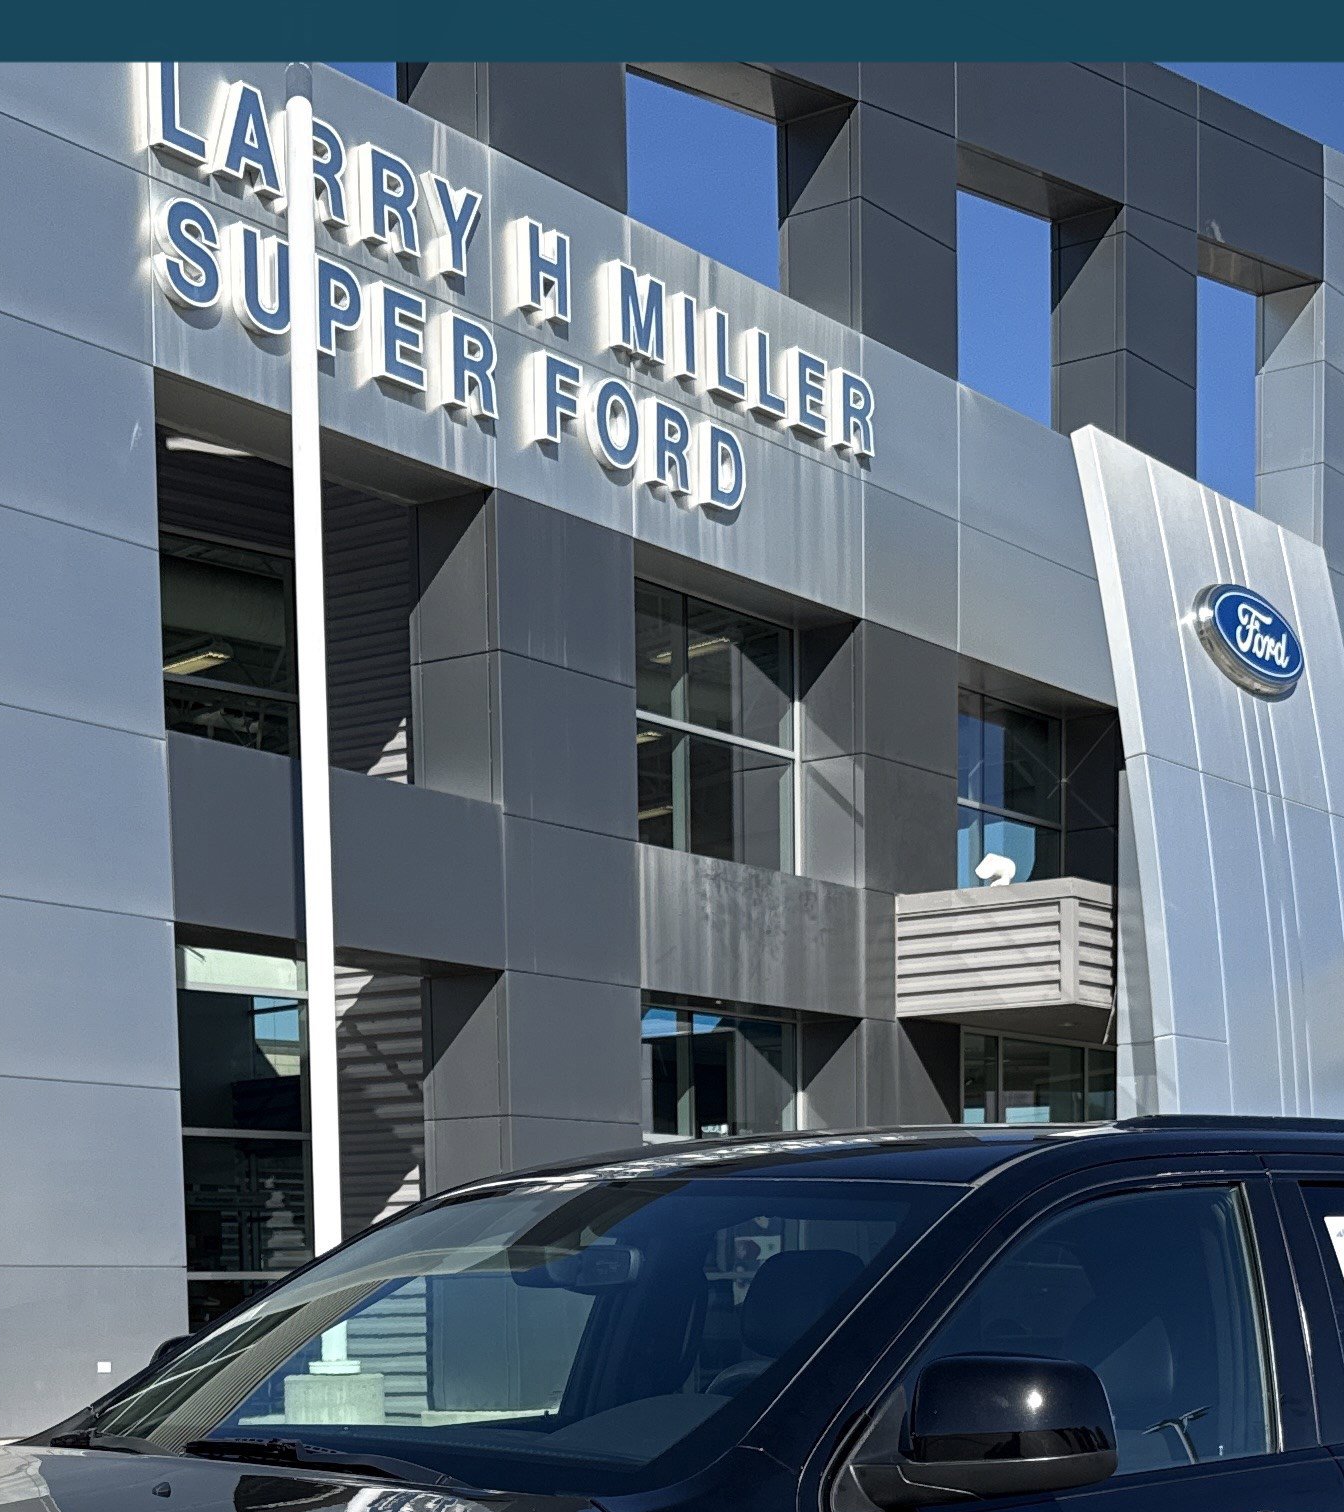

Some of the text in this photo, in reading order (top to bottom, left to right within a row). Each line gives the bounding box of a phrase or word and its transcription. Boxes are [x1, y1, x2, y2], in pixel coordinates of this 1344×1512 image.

[150, 62, 876, 459] LARRY H MILLER
[153, 195, 747, 513] SUPER FORD
[1235, 602, 1290, 669] Ford
